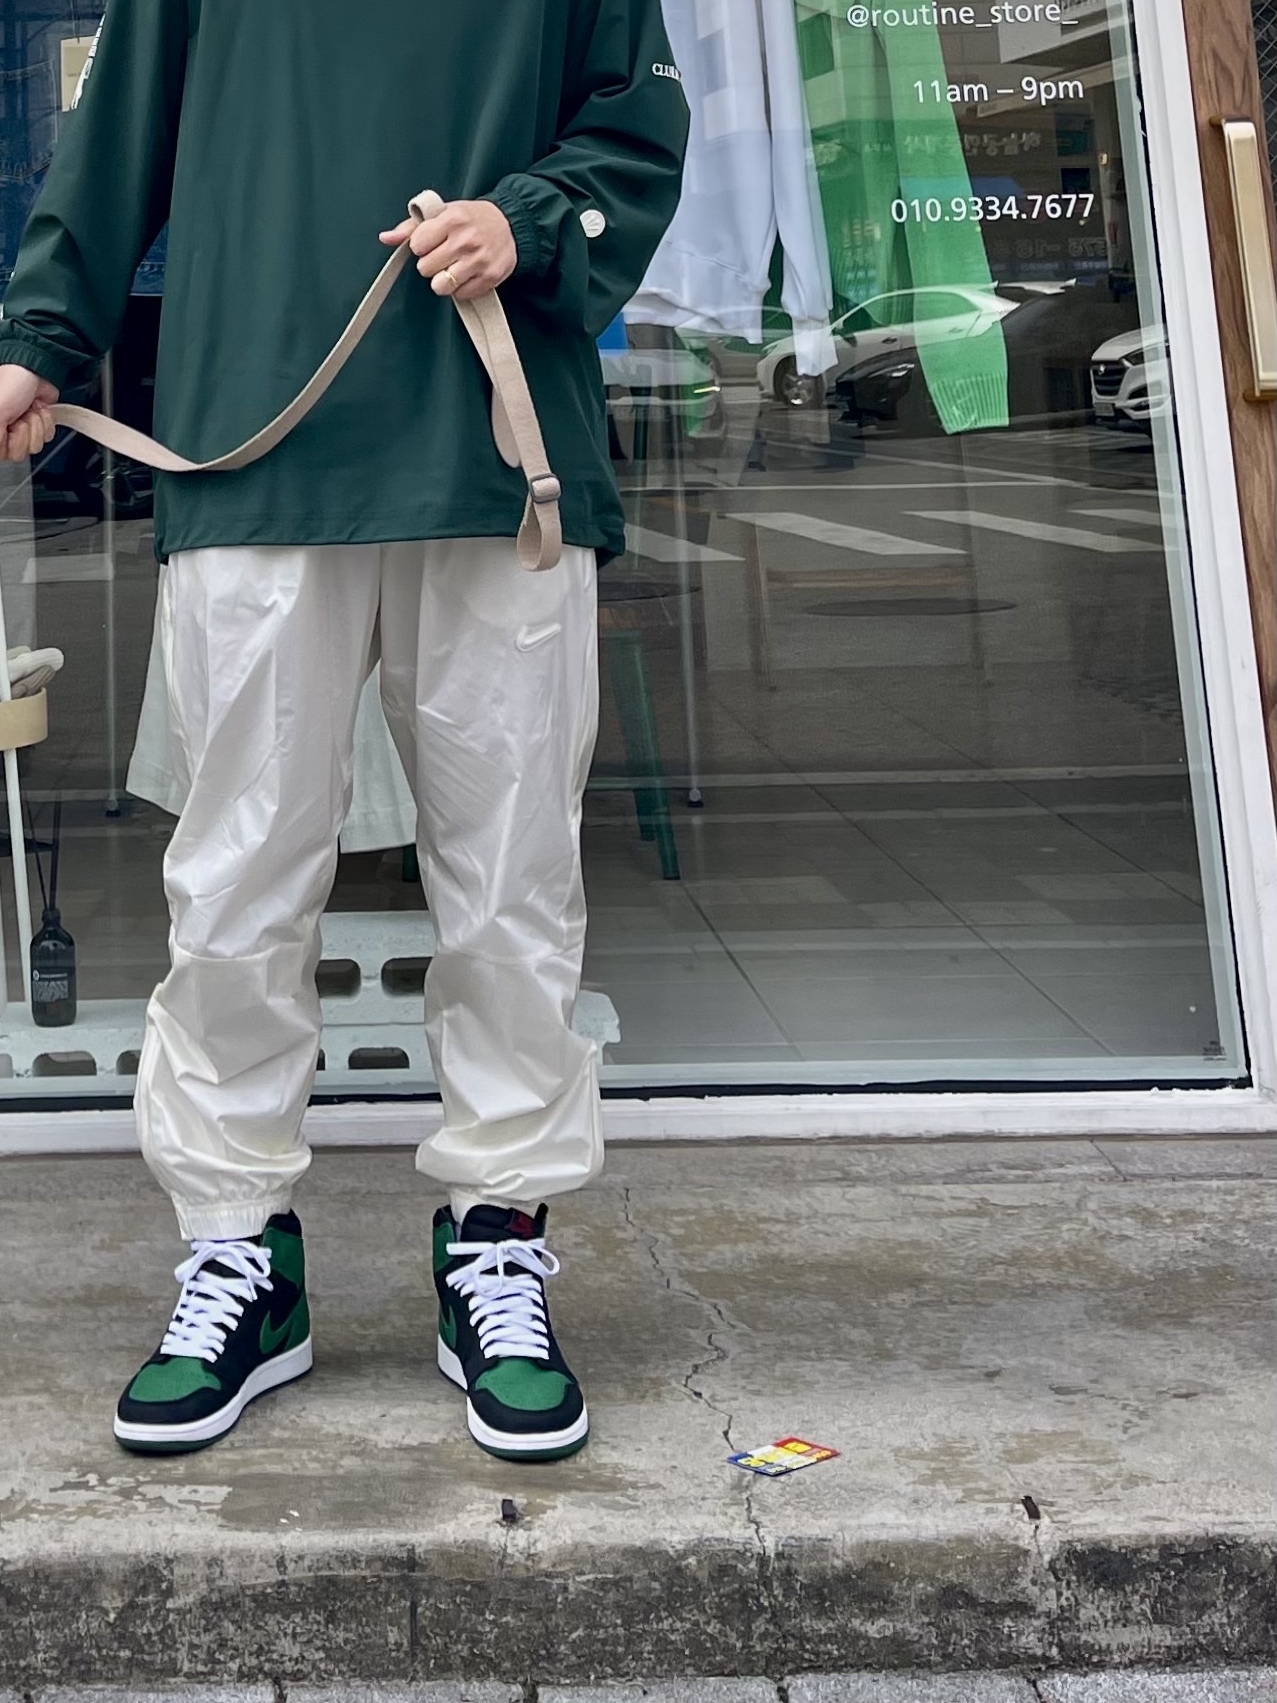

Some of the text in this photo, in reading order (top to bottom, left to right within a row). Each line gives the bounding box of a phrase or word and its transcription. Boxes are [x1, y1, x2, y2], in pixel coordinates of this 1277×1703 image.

[846, 0, 1079, 28] @routine_store_
[913, 79, 988, 103] 11am
[1020, 75, 1084, 106] 9pm
[890, 193, 1095, 223] 010.9334.7677
